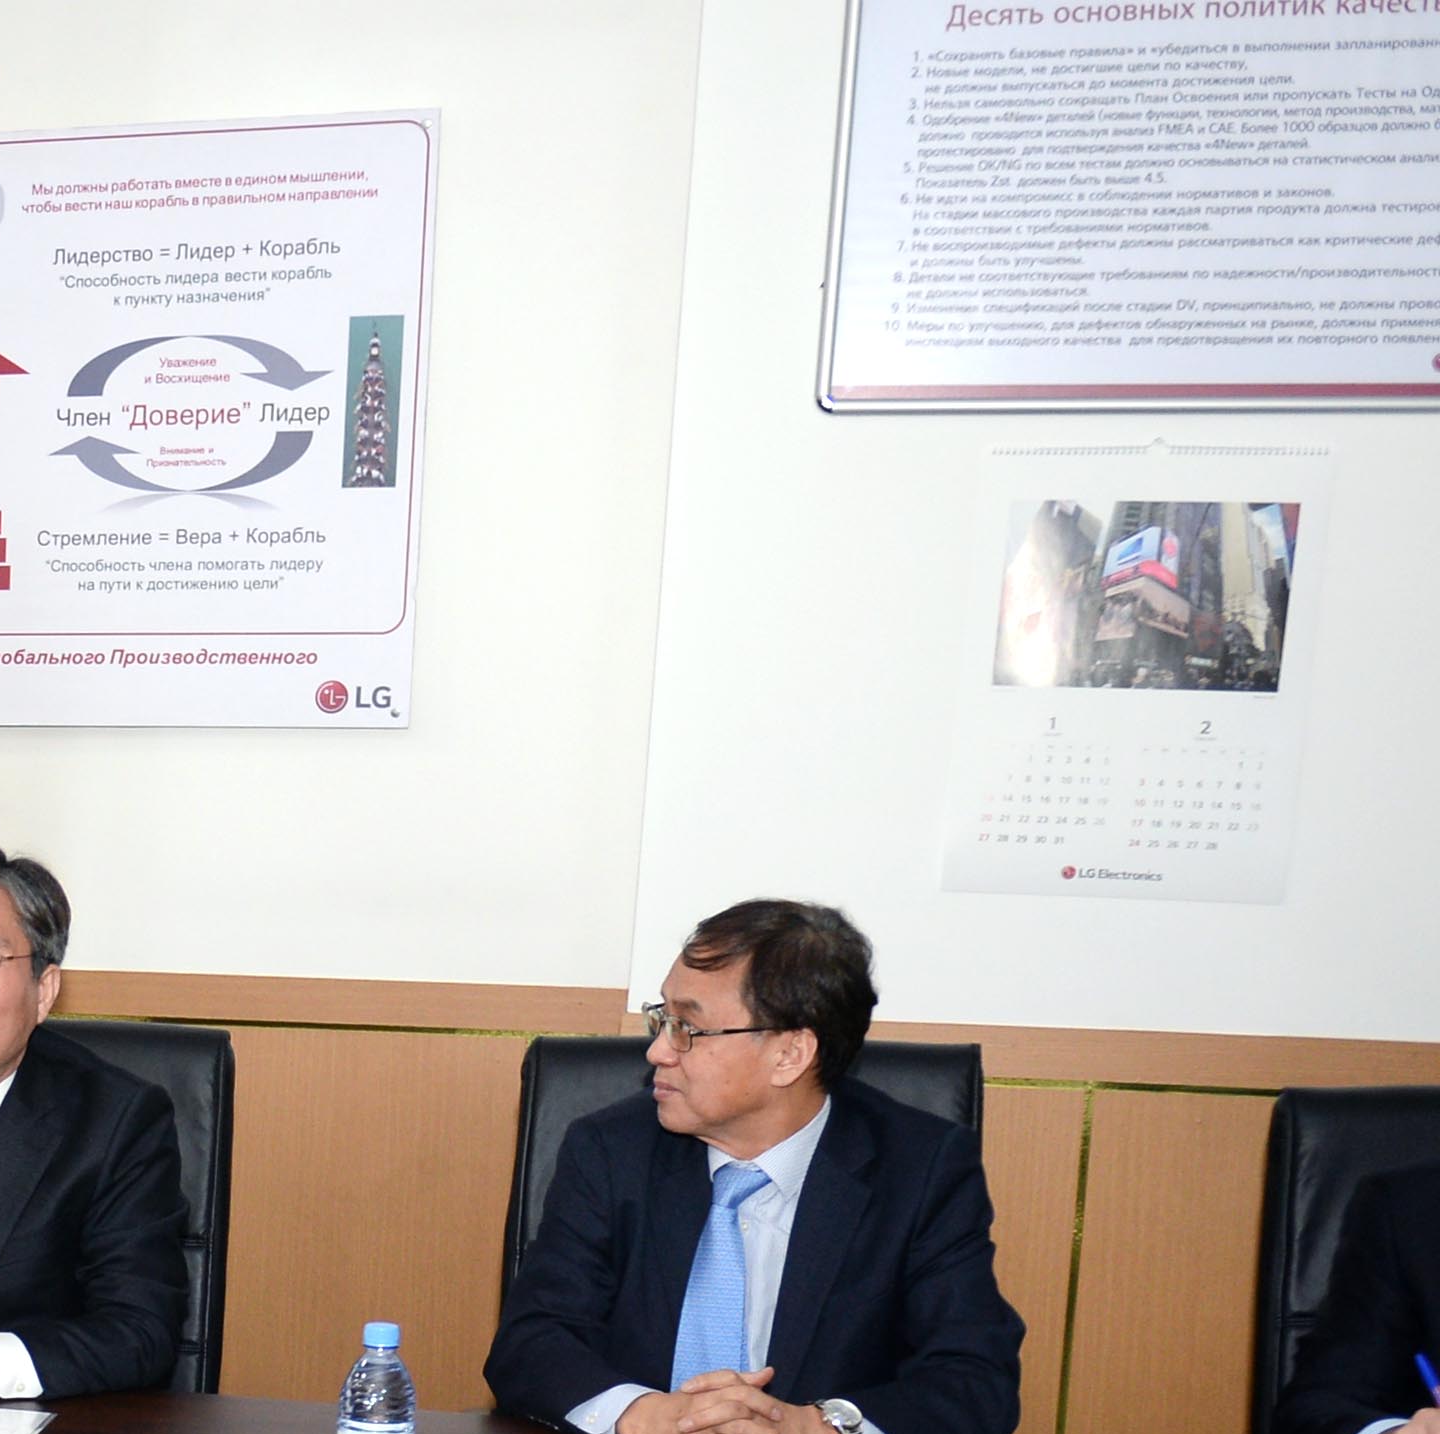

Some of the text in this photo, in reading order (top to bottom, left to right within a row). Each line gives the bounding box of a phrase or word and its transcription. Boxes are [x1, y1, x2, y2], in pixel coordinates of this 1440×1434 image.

[946, 4, 1043, 32] Десять
[1054, 2, 1195, 24] основных
[1205, 0, 1325, 19] политик
[31, 170, 368, 197] Мы должны работать вместе в едином мышлении,
[22, 188, 378, 214] чтобы вести наш корабль в правильном направлении
[53, 248, 153, 268] Лидерство
[176, 242, 235, 263] Лидер
[260, 237, 340, 261] Корабль
[165, 272, 219, 287] лидера
[225, 271, 267, 283] вести
[271, 265, 332, 283] корабль
[114, 296, 120, 306] к
[125, 293, 173, 309] пункту
[160, 357, 216, 368] Уважение
[144, 372, 230, 385] и Восхищение
[57, 407, 110, 427] Член
[260, 402, 330, 424] Лидер
[37, 529, 152, 550] Стремление
[176, 528, 221, 549] Вера
[246, 527, 326, 547] Корабль
[149, 560, 192, 572] члена
[198, 560, 265, 571] помогать
[270, 560, 323, 578] лидеру
[78, 580, 95, 591] на
[99, 580, 131, 594] пути
[136, 580, 143, 591] к
[146, 579, 238, 593] достижению
[110, 648, 317, 668] Производственного
[355, 685, 392, 709] LG
[1049, 716, 1212, 735] 1 2
[1078, 867, 1163, 882] LG Electronics
